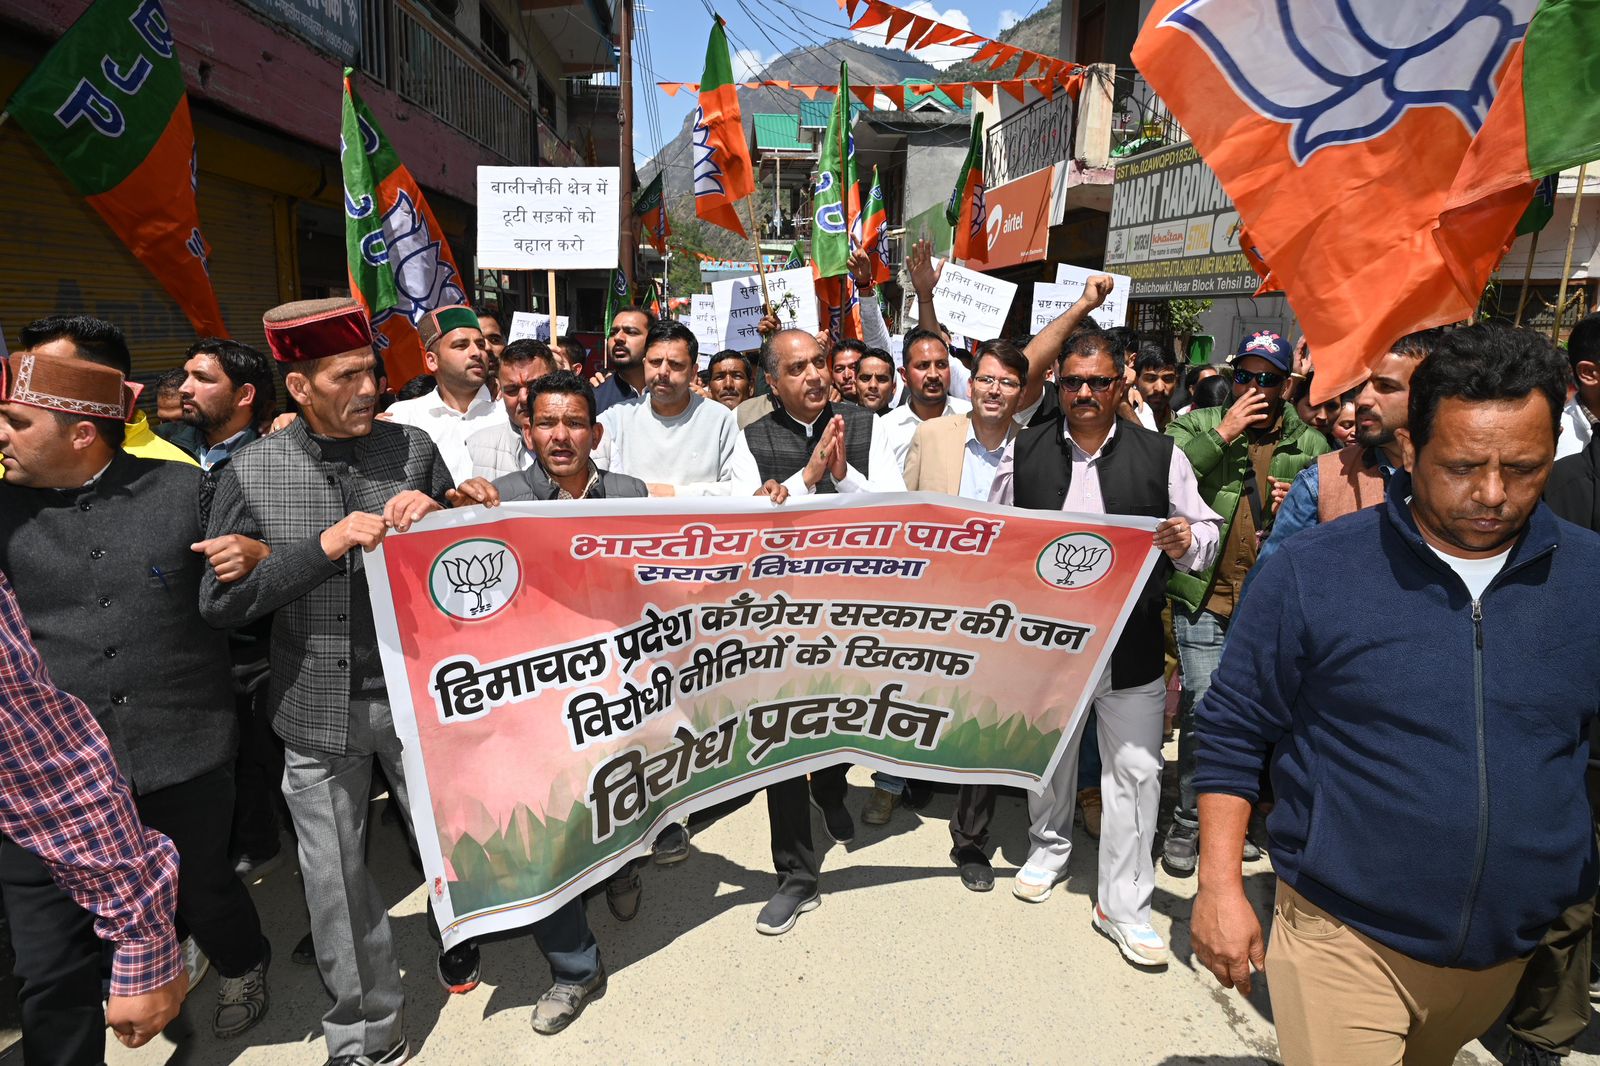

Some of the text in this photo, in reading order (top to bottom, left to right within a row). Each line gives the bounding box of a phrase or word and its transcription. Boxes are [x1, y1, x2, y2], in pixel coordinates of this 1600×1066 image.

[54, 0, 173, 137] BJP
[1116, 165, 1129, 180] GST
[490, 177, 608, 195] बालीचौकी क्षेत्र में
[1110, 163, 1234, 228] BHARAT HARDWAR
[502, 205, 596, 227] टूटी सड़कों को
[1003, 211, 1024, 234] airtel
[513, 234, 585, 255] बहाल करो
[1151, 229, 1185, 244] khaitan
[1170, 247, 1183, 256] enough
[768, 277, 787, 291] तेरी
[945, 271, 972, 287] पुलिस
[1192, 278, 1214, 291] Block
[1217, 276, 1242, 290] Tehsil
[934, 286, 1001, 315] ालीचौकी बहाल
[949, 310, 967, 323] करो
[572, 519, 1001, 559] भारतीय जनता पार्टी
[635, 555, 926, 583] सराज विधानसभा
[434, 592, 1091, 719] हिमाचल प्रदेश काँग्रेस सरकार की जन
[567, 635, 975, 746] विरोधी नीतियों के खिलाफ
[589, 683, 949, 839] विरोध प्रदर्शन
